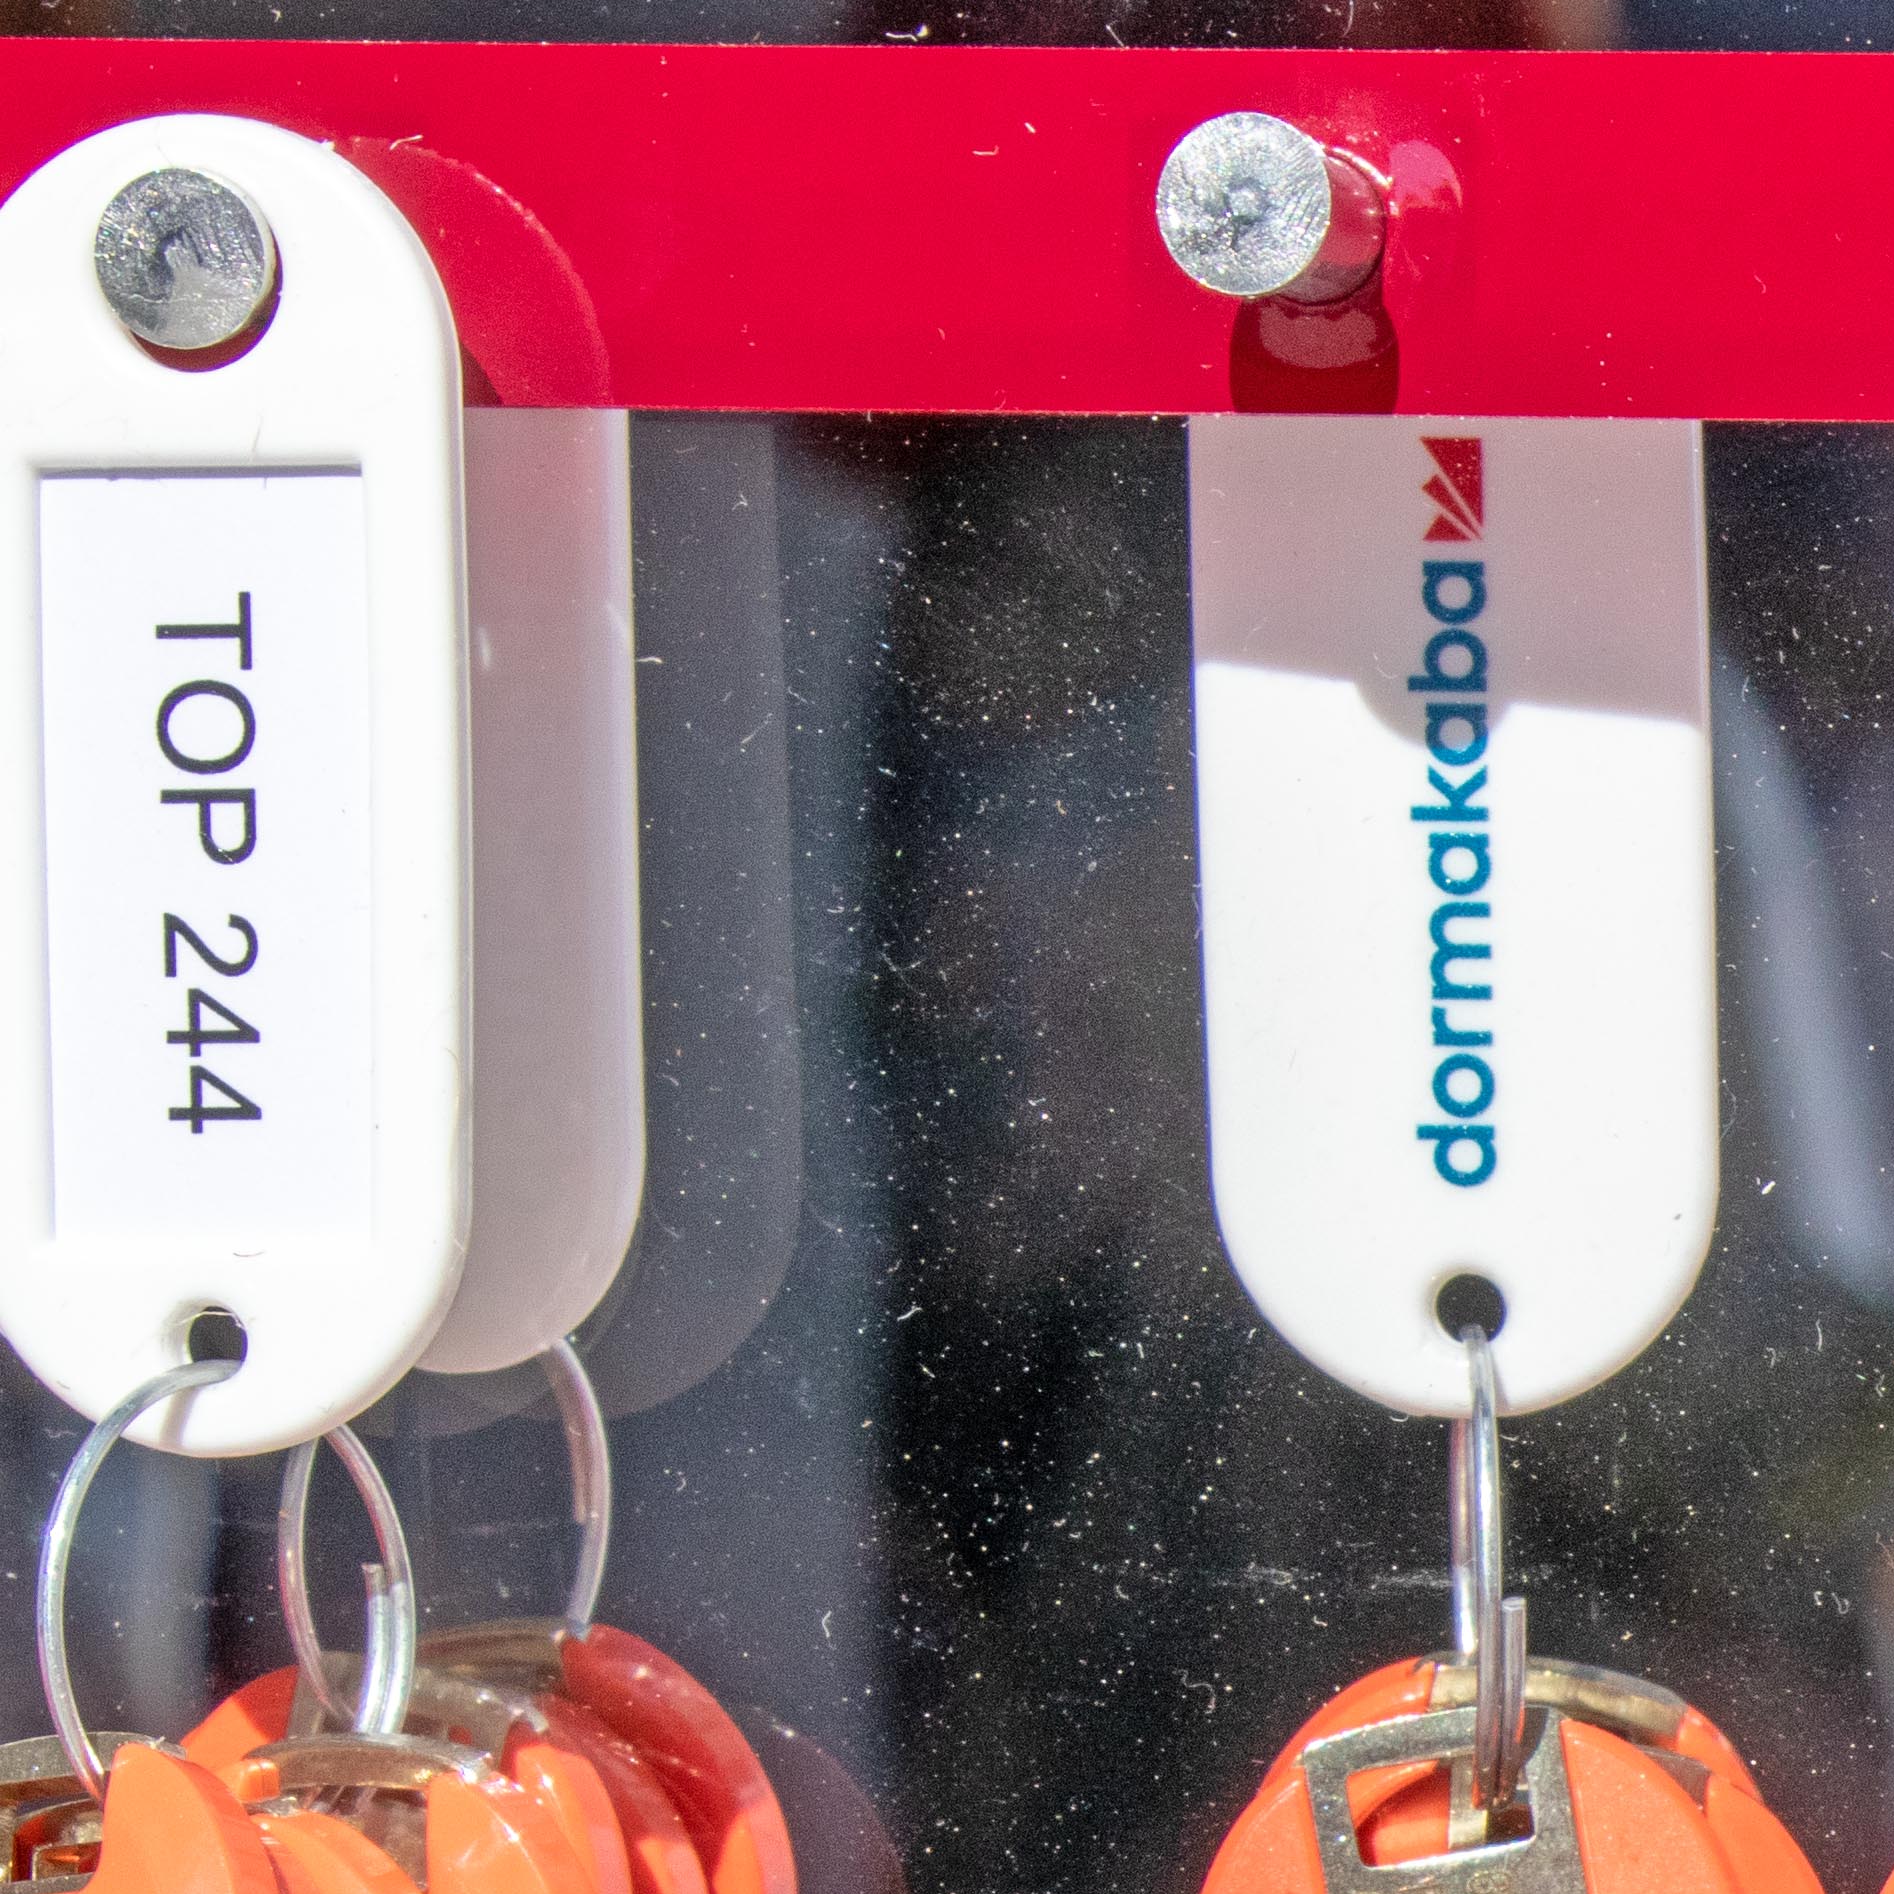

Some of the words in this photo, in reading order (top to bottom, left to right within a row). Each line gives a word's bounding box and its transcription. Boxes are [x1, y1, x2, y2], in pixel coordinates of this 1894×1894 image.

[155, 590, 257, 866] TOP
[1407, 559, 1497, 1189] dormakaba
[163, 912, 263, 1135] 244
